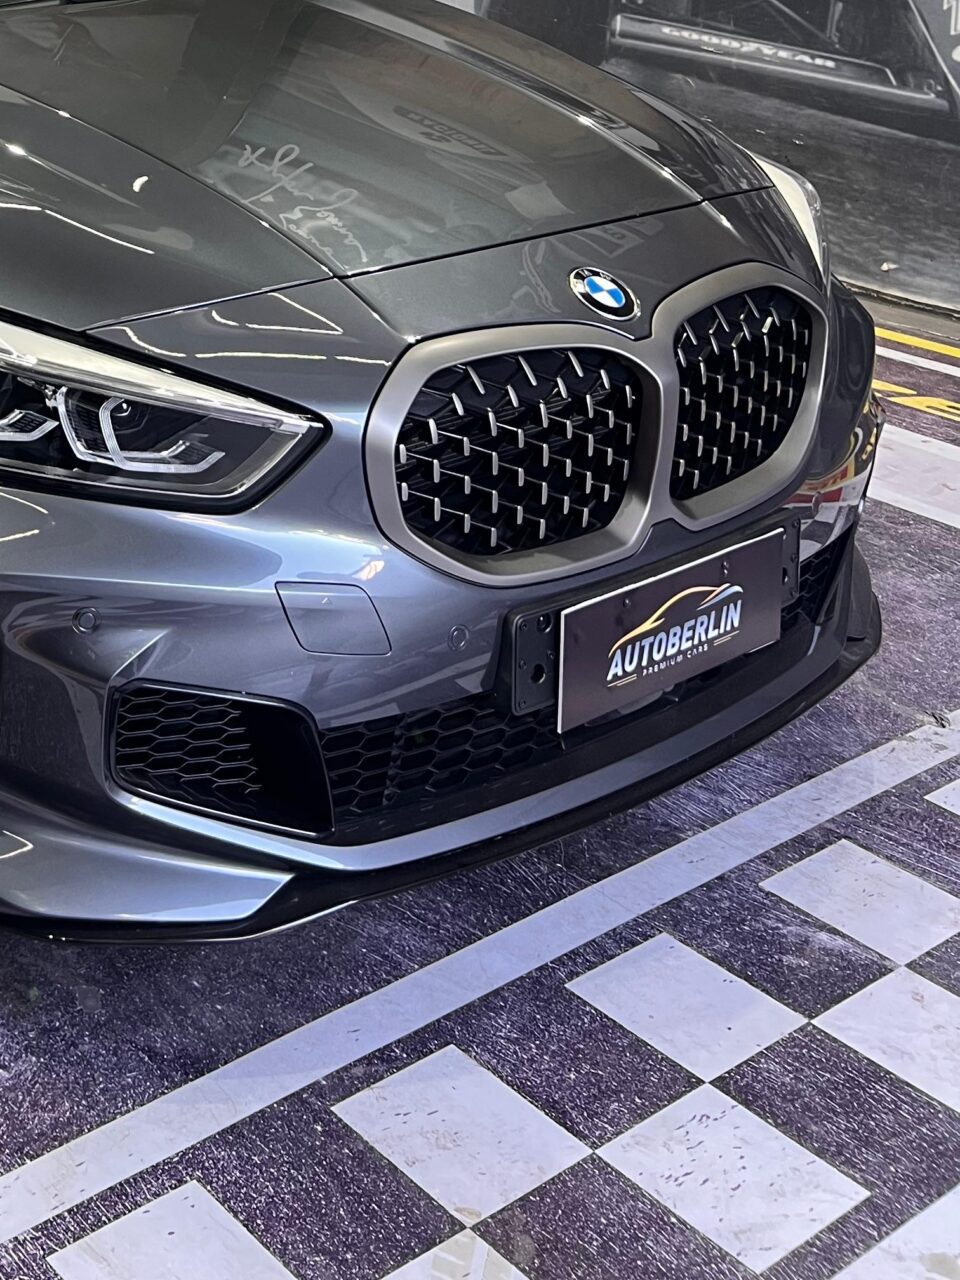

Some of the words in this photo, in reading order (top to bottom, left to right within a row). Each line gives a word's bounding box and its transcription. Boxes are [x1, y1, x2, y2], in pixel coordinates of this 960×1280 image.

[606, 599, 742, 681] AUTOBERLIN
[642, 656, 683, 677] PREMIUM
[687, 643, 709, 659] CARS
